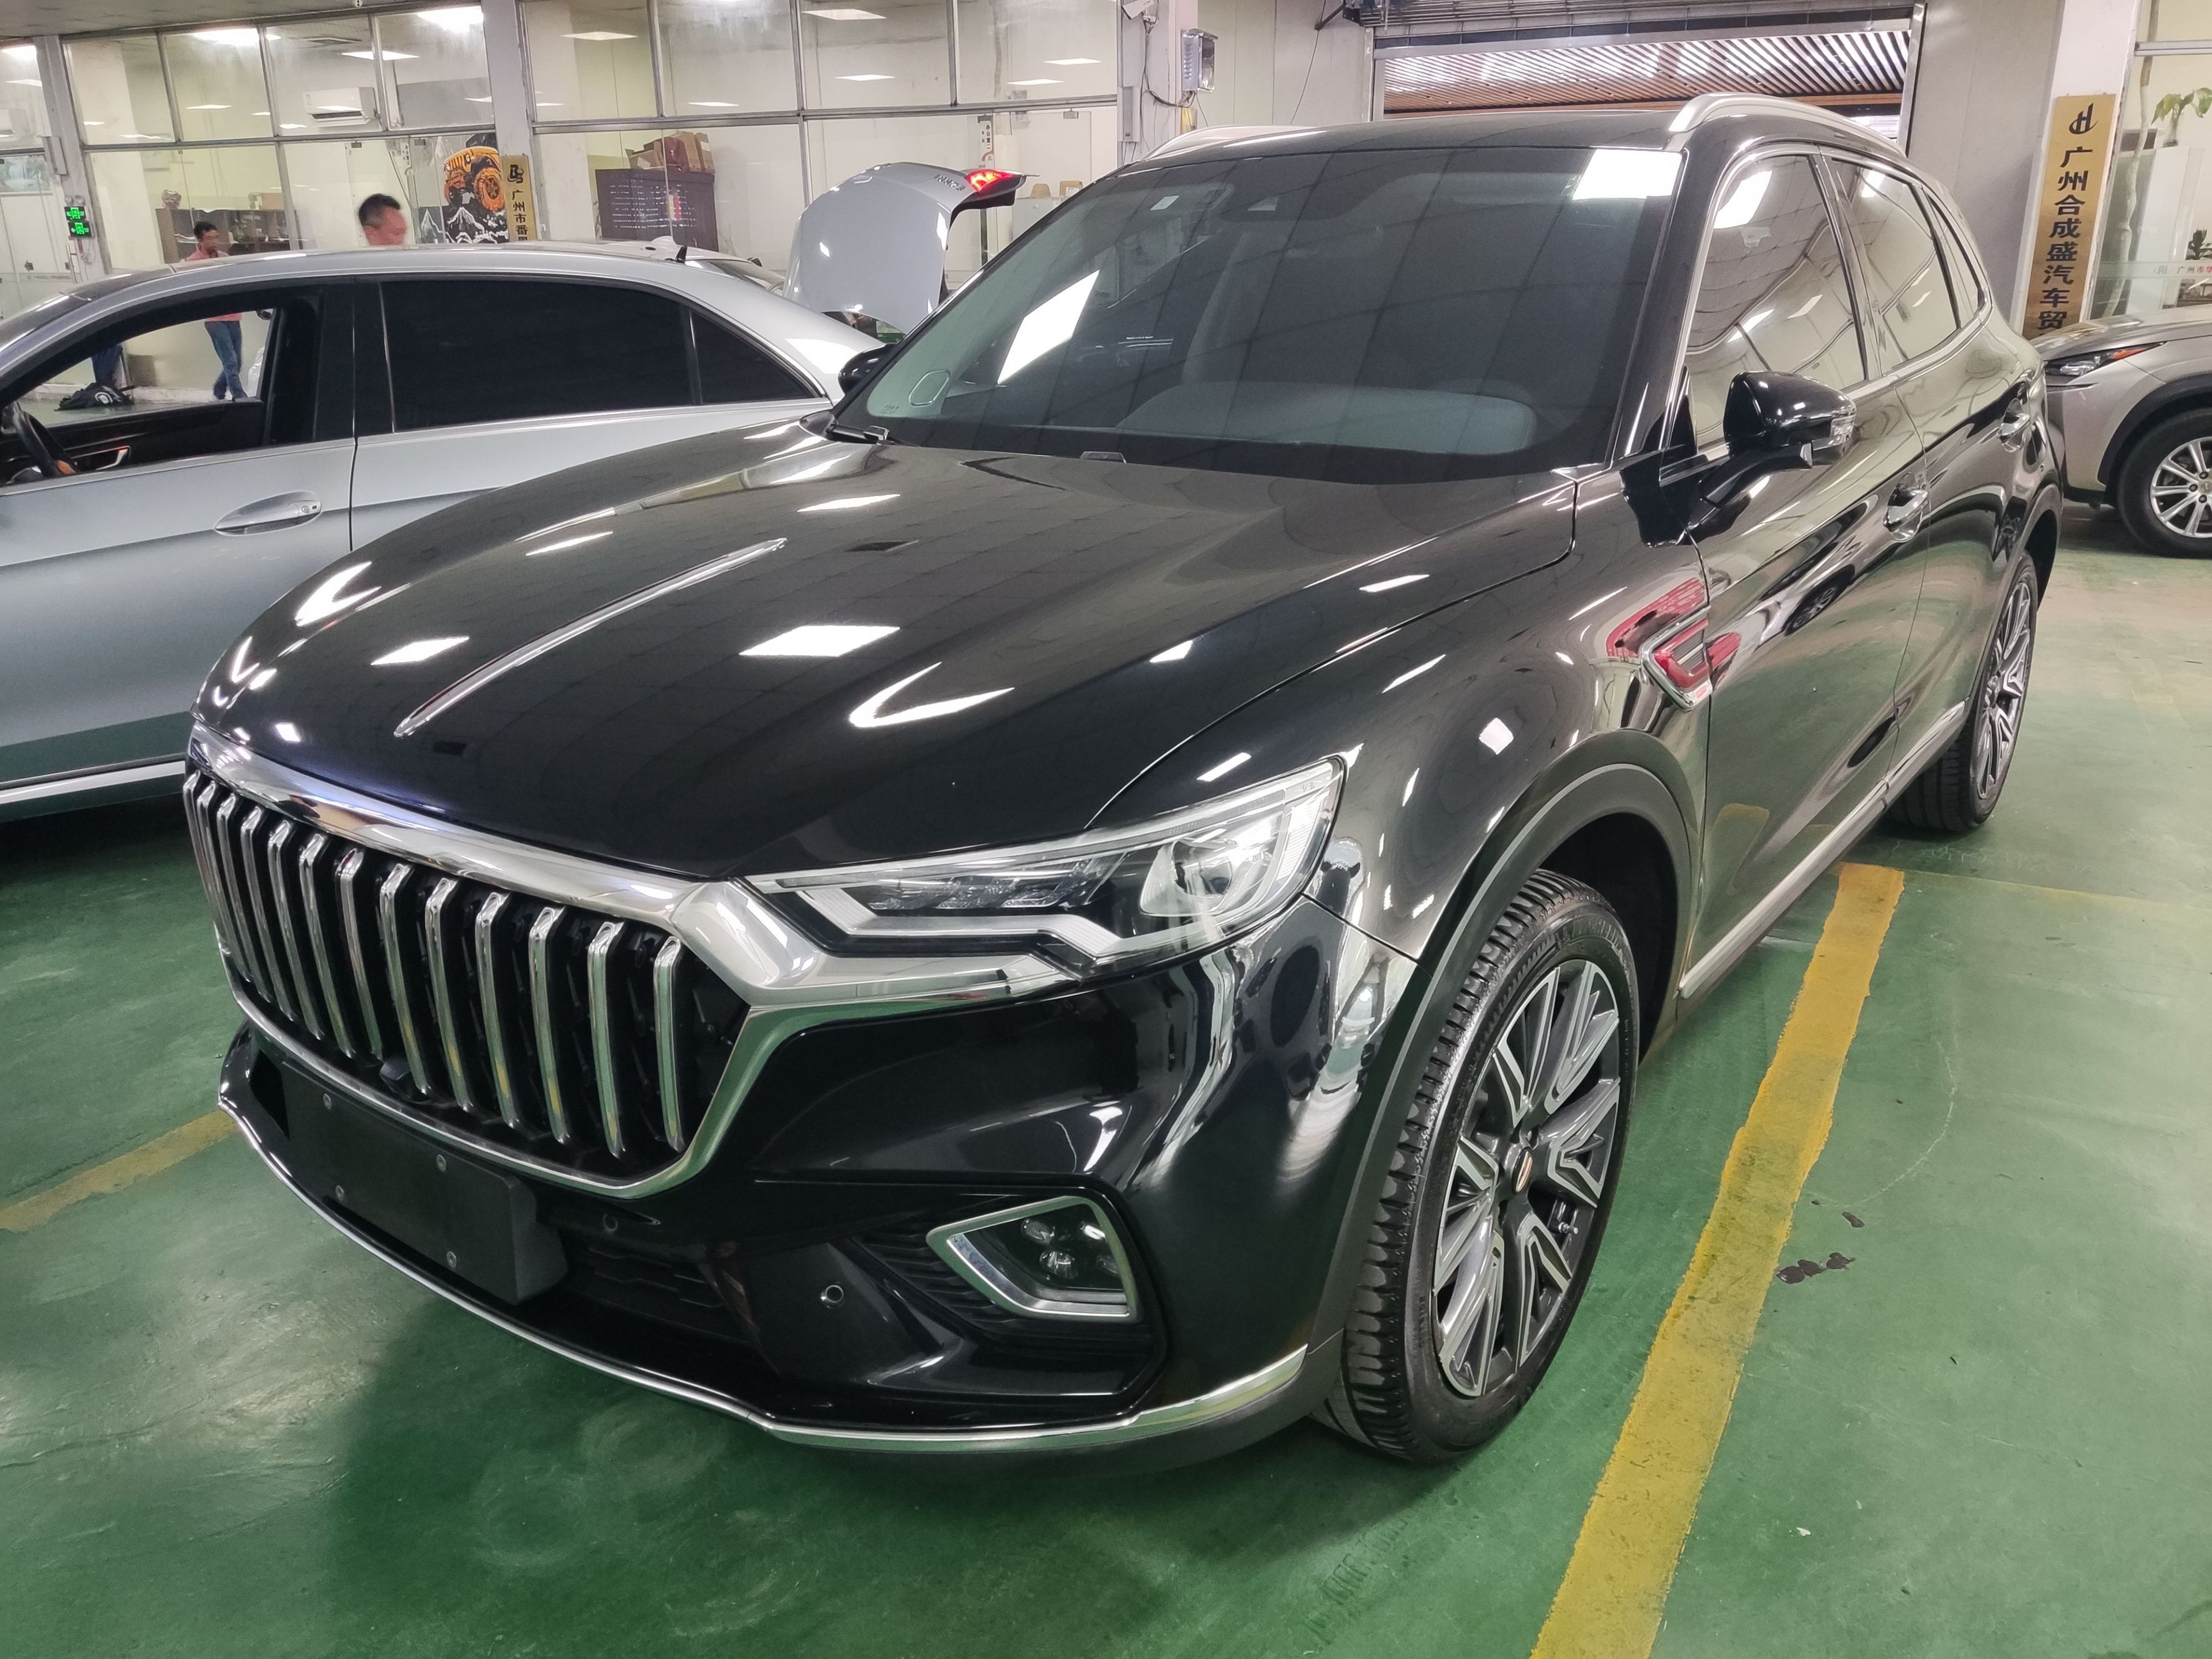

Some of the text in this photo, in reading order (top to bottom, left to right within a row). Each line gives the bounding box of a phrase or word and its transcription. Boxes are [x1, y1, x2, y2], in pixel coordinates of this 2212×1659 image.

[2037, 146, 2093, 336] 广州合成盛汽车贸
